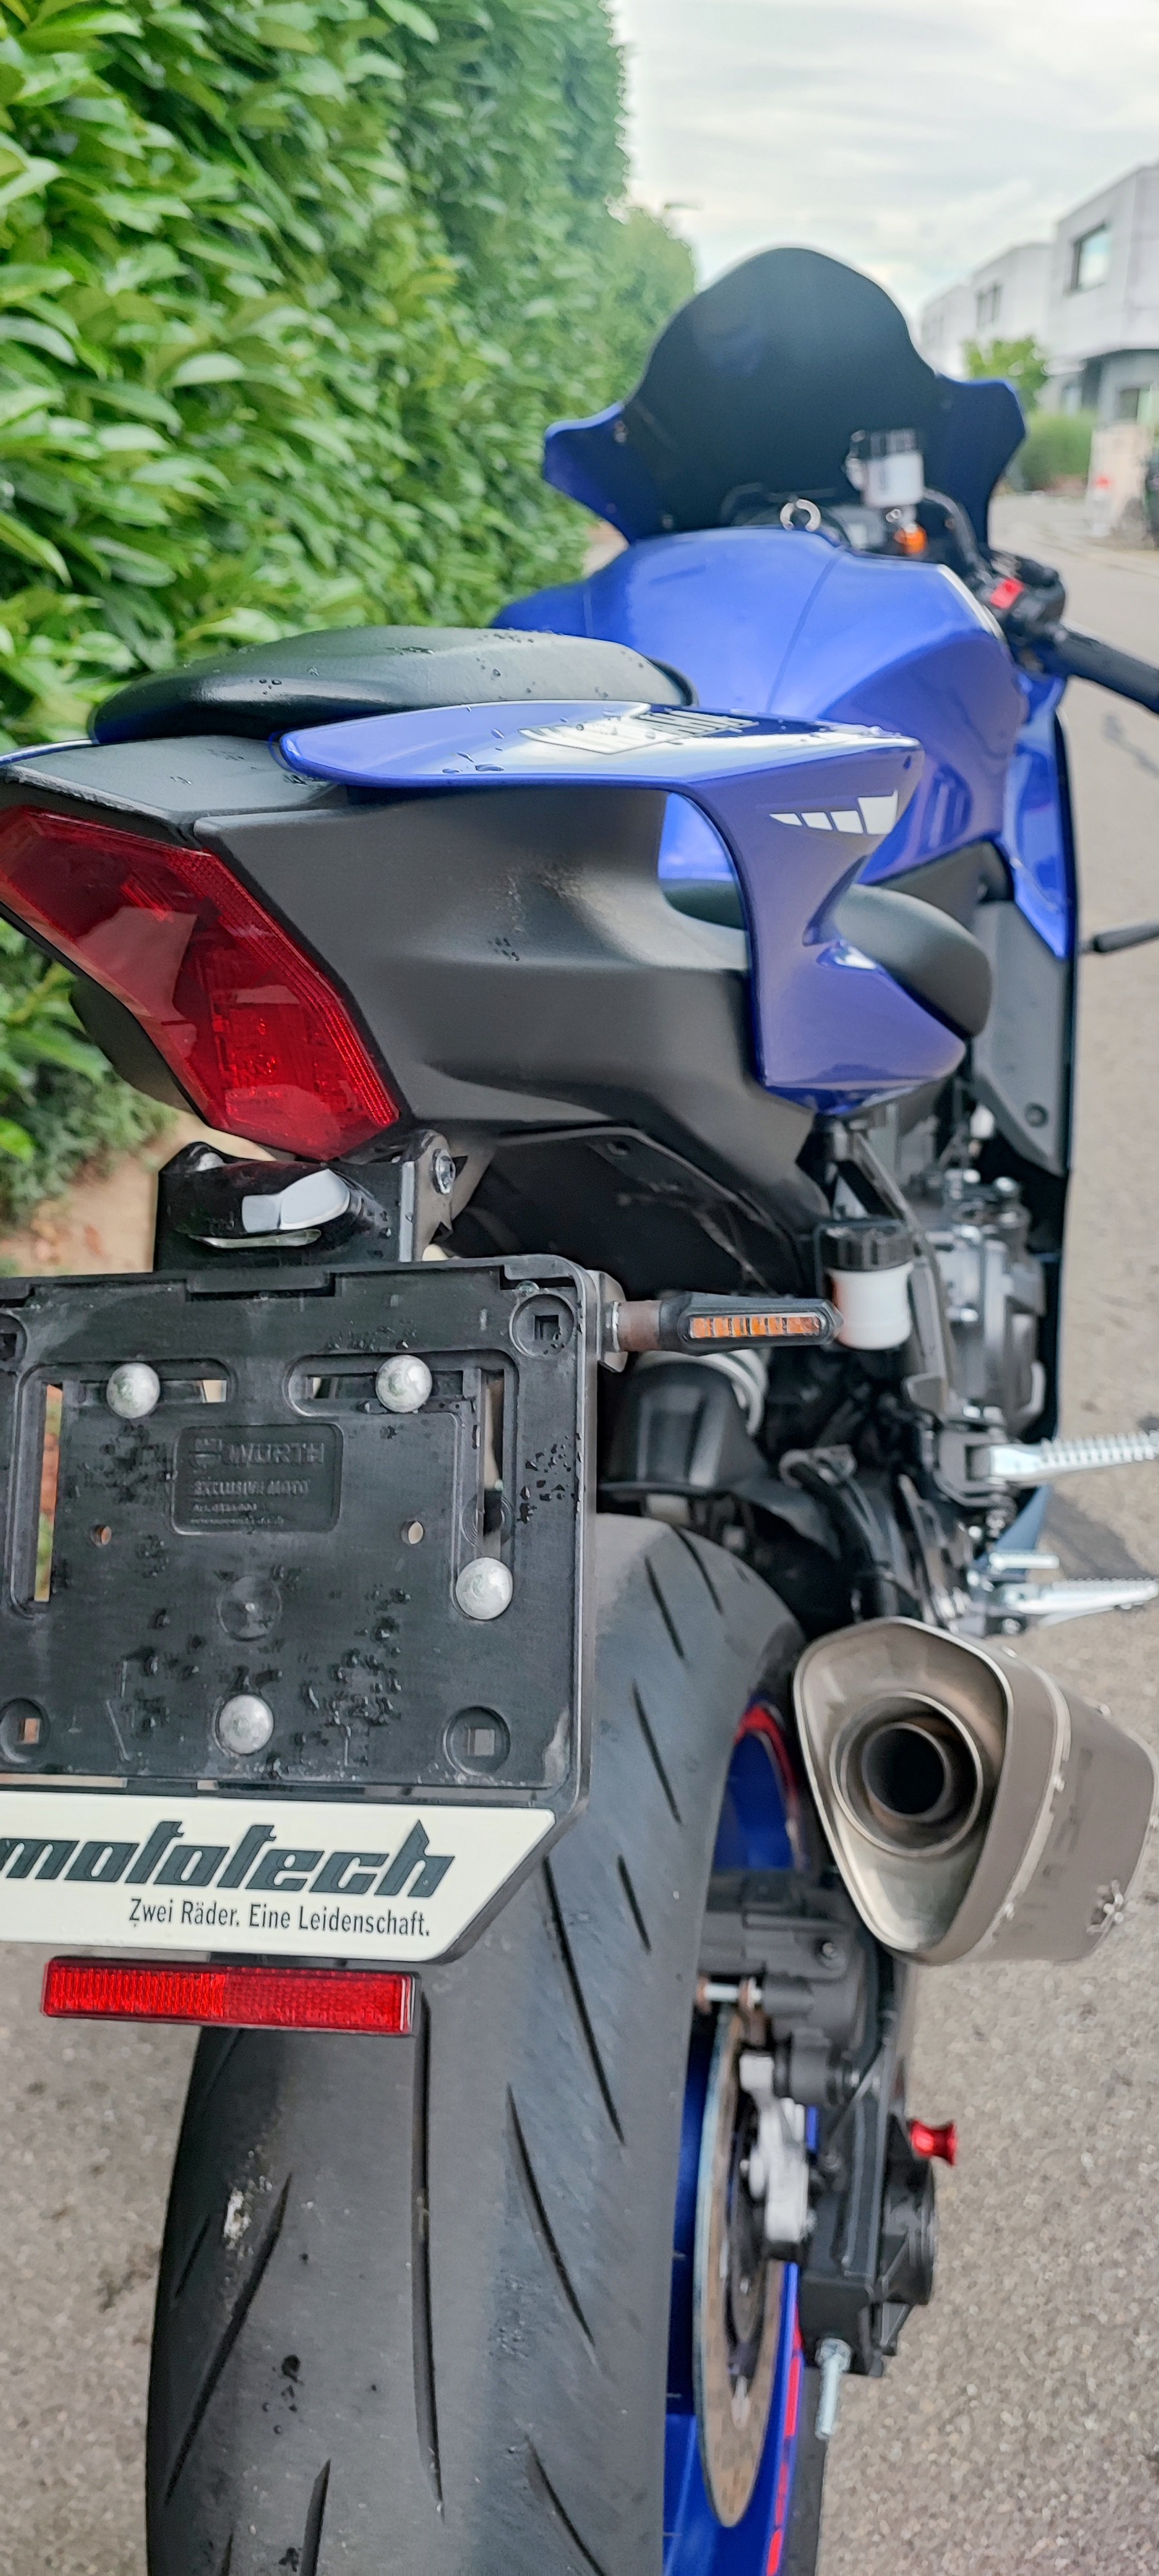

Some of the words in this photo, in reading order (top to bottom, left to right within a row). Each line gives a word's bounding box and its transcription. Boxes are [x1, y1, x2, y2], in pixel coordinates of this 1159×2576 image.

[518, 709, 756, 755] YAAHA
[0, 1819, 456, 1898] mototech
[129, 1898, 174, 1925] Zwei
[180, 1900, 241, 1928] Räder.
[248, 1902, 291, 1931] Eine
[298, 1906, 430, 1937] Leidenschaft.
